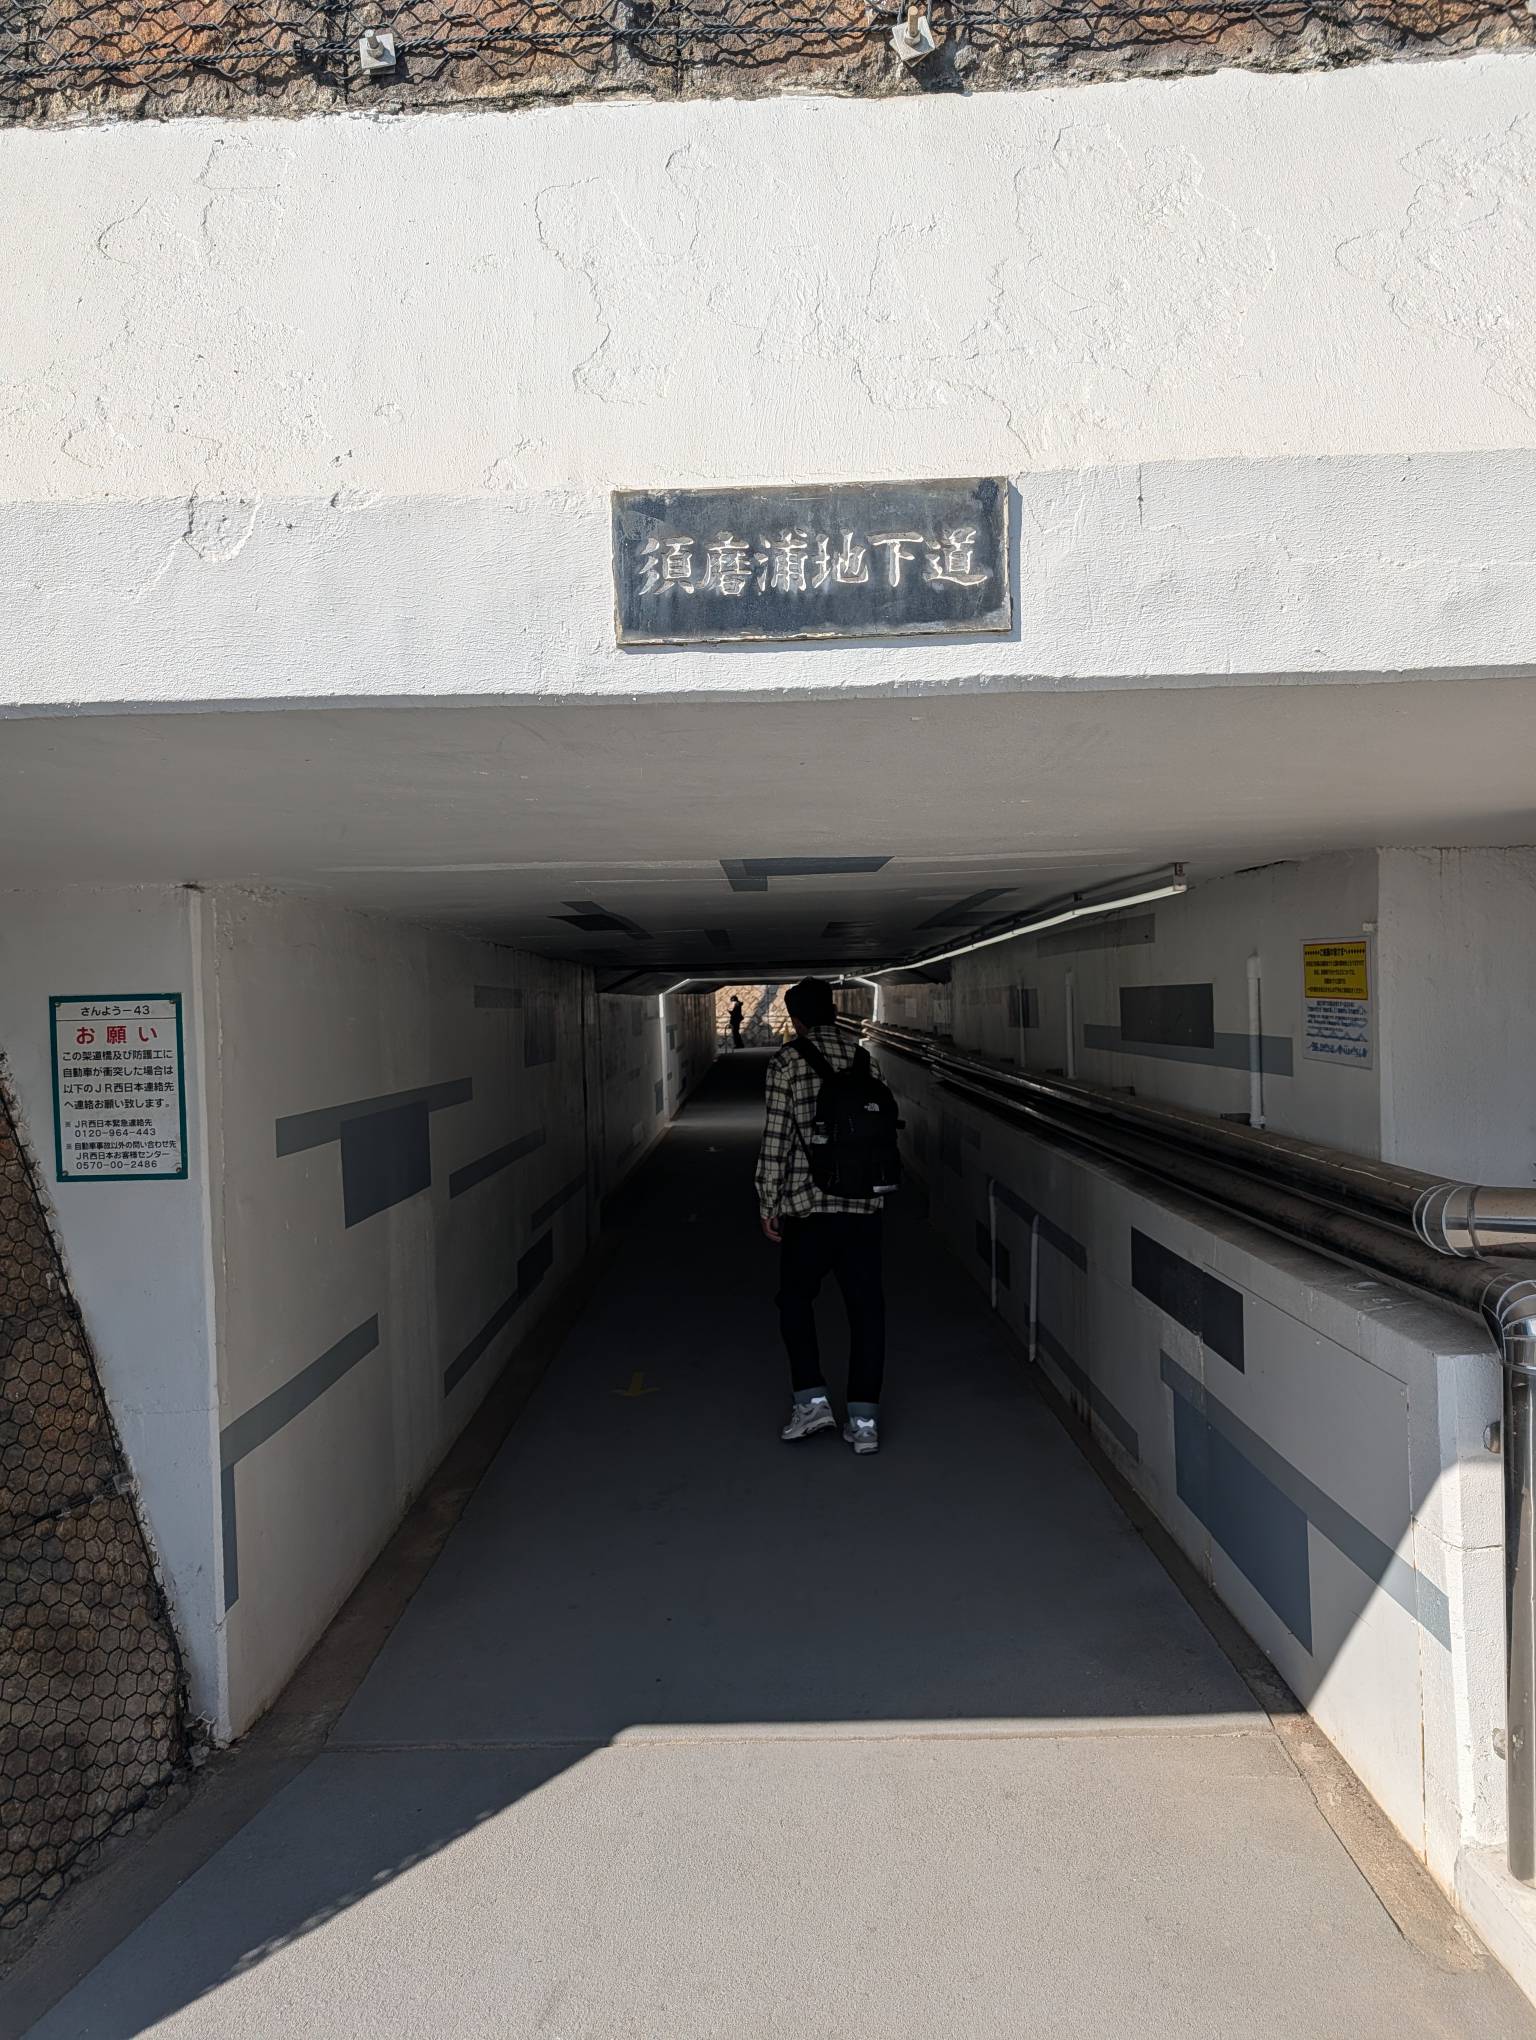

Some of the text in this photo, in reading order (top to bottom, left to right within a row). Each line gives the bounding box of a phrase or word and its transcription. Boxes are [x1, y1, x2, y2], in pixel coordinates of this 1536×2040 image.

[637, 526, 993, 597] 須磨浦地下道
[76, 1025, 158, 1045] お願い
[63, 1049, 173, 1062] この架道橋及び防護工に
[63, 1066, 173, 1077] 自動車が衝突した場合は
[64, 1081, 174, 1093] 以下のJR西日本連絡先
[64, 1098, 170, 1109] へ連絡お願い致します。
[74, 1128, 156, 1138] 0120-964-443
[76, 1160, 158, 1170] 0570-00-2486
